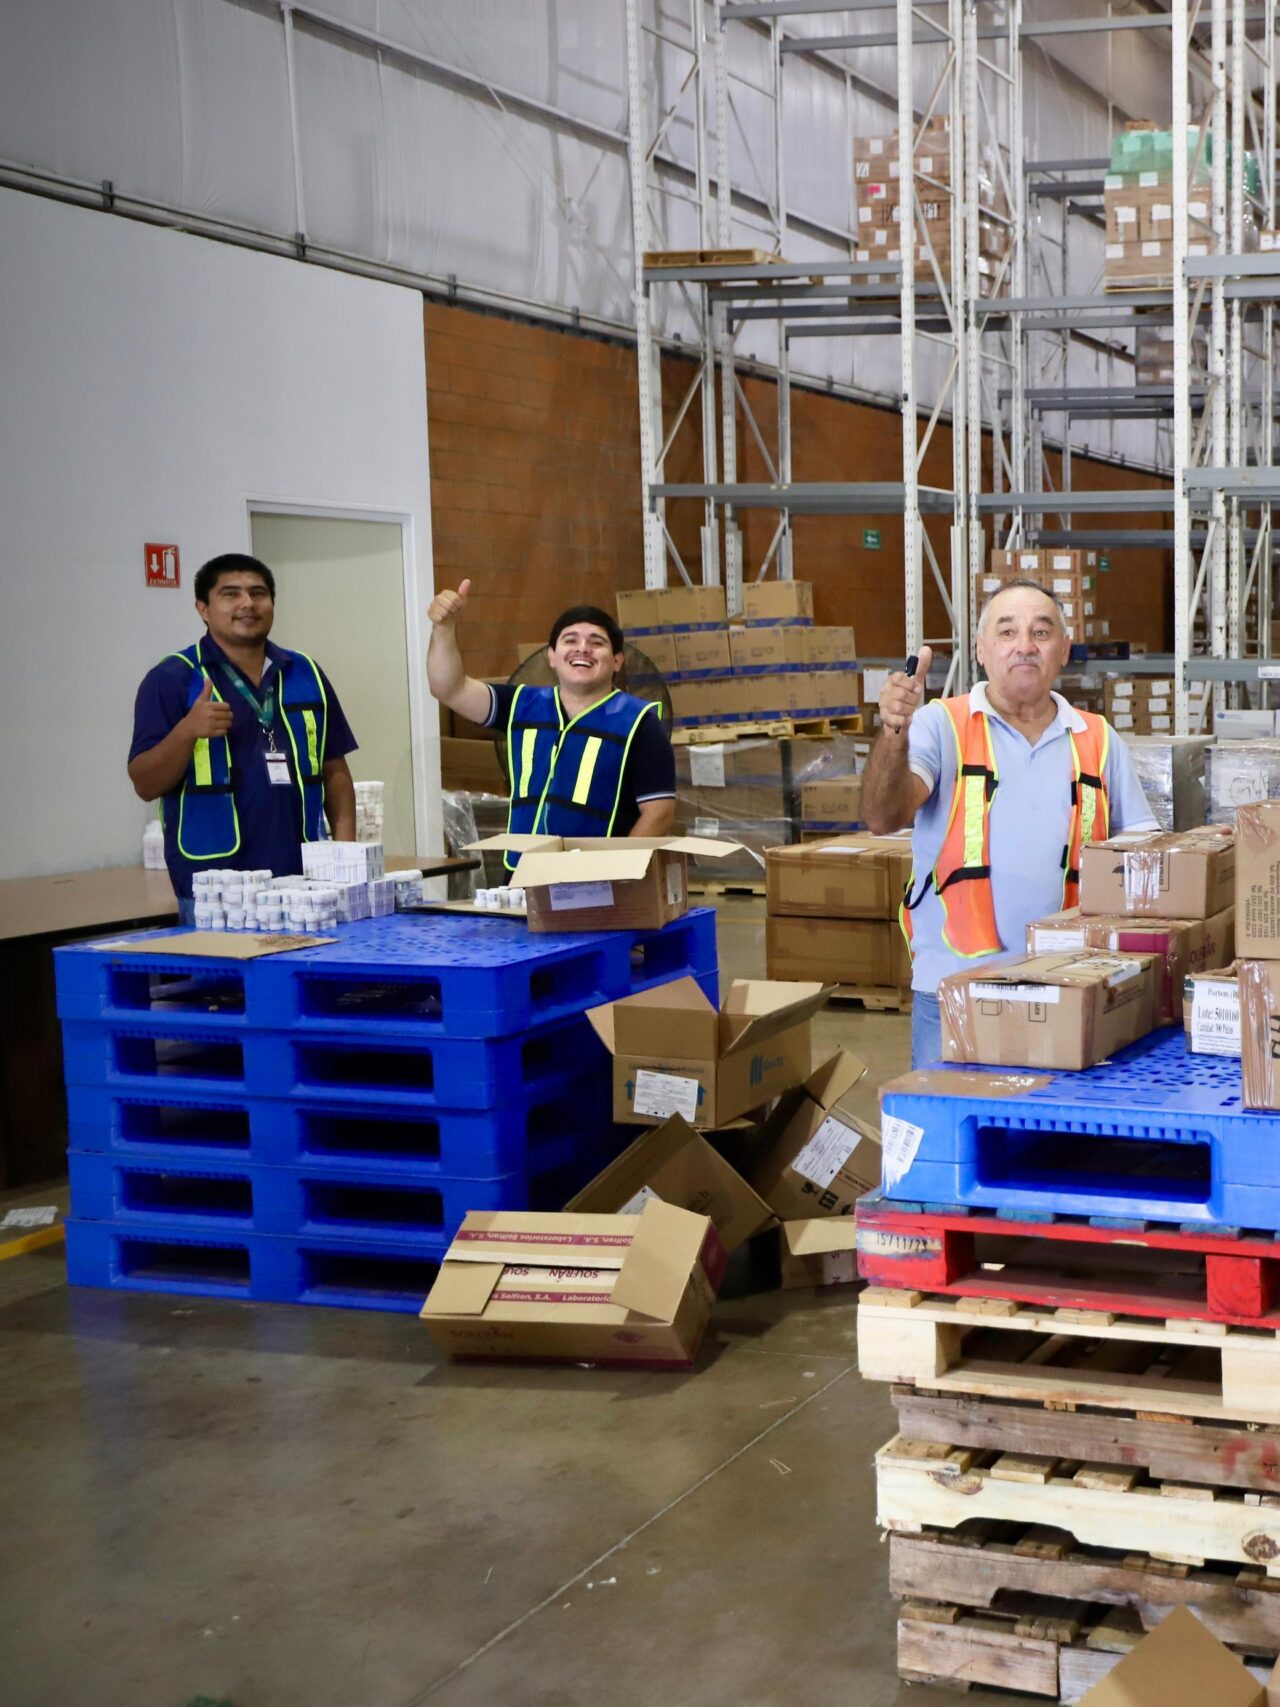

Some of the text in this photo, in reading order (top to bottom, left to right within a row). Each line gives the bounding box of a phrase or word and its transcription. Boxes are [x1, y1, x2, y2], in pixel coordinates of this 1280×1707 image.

[1197, 1005, 1214, 1020] Lote:
[518, 1233, 573, 1243] Laboratorios
[583, 1235, 599, 1243] S.A.
[499, 1292, 532, 1301] Solfran,
[534, 1293, 551, 1301] S.A.
